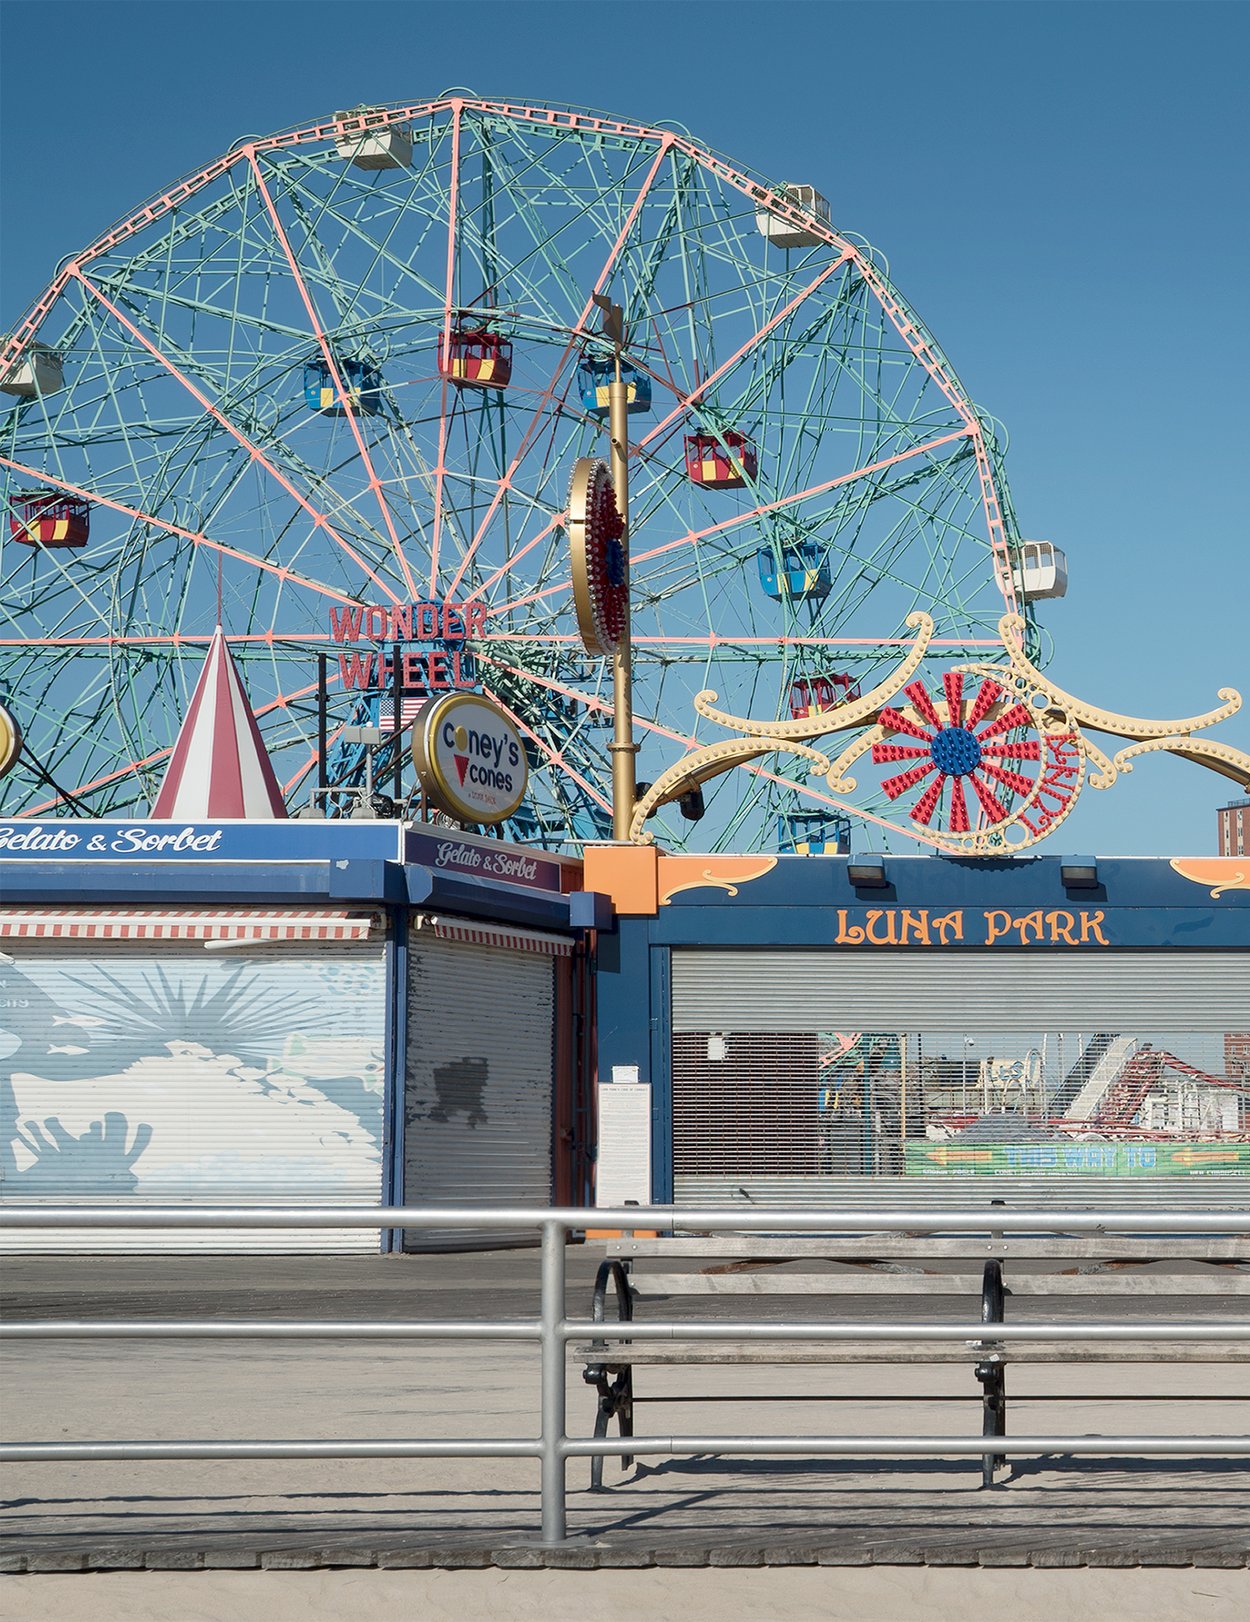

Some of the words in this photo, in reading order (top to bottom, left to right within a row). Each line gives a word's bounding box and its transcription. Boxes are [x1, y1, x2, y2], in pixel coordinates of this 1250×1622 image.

[329, 602, 488, 643] WONDER
[338, 651, 476, 690] WHEEL
[469, 763, 513, 792] cones
[1018, 733, 1080, 838] LUNA
[0, 827, 82, 851] Gelato
[87, 835, 107, 851] &
[111, 827, 223, 853] Sorbet
[435, 842, 481, 867] Gelato
[483, 856, 492, 871] &
[493, 854, 537, 880] Sorbet
[834, 909, 964, 945] LUNA
[984, 910, 1110, 945] PARK
[1004, 1146, 1057, 1168] THIS
[1062, 1146, 1117, 1168] WAY
[1123, 1146, 1157, 1168] TO
